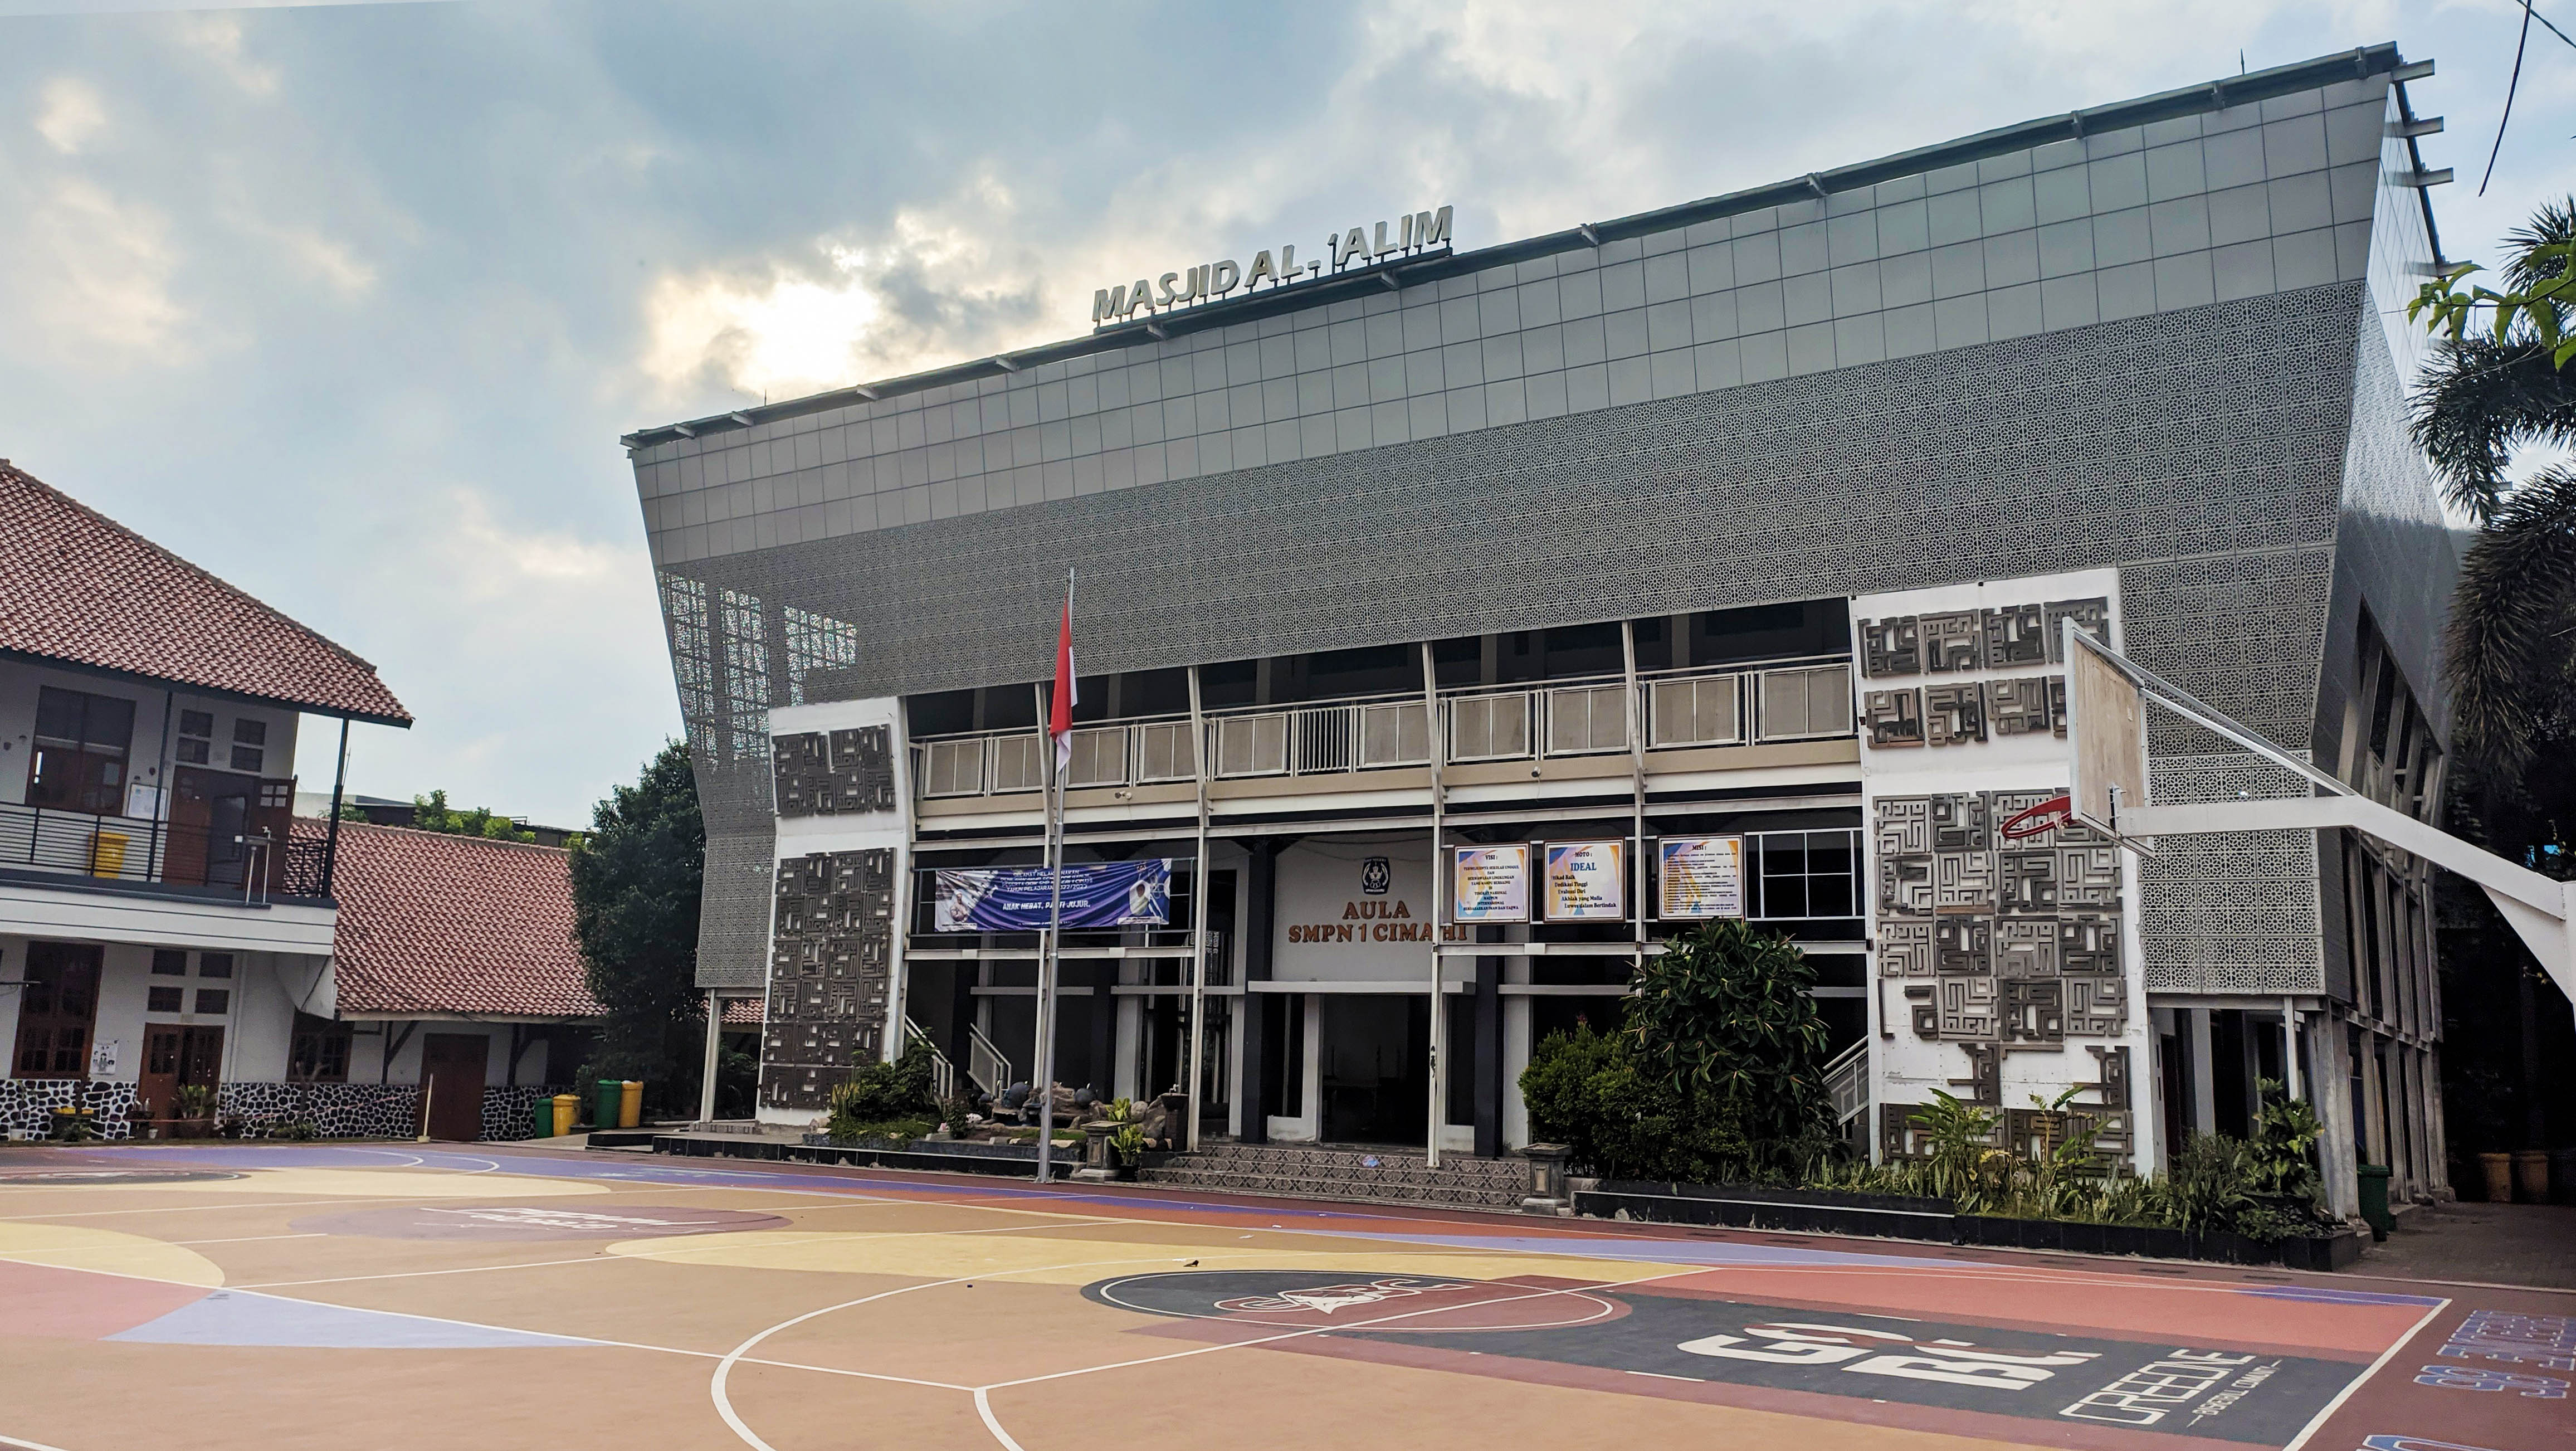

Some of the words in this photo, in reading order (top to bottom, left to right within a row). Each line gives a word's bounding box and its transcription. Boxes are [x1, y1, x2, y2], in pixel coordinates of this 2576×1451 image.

[1092, 260, 1241, 322] MASJID
[1570, 863, 1597, 871] IDEAL
[1342, 900, 1411, 919] AULA
[1289, 924, 1352, 943] SMPN
[1358, 924, 1366, 942] 1
